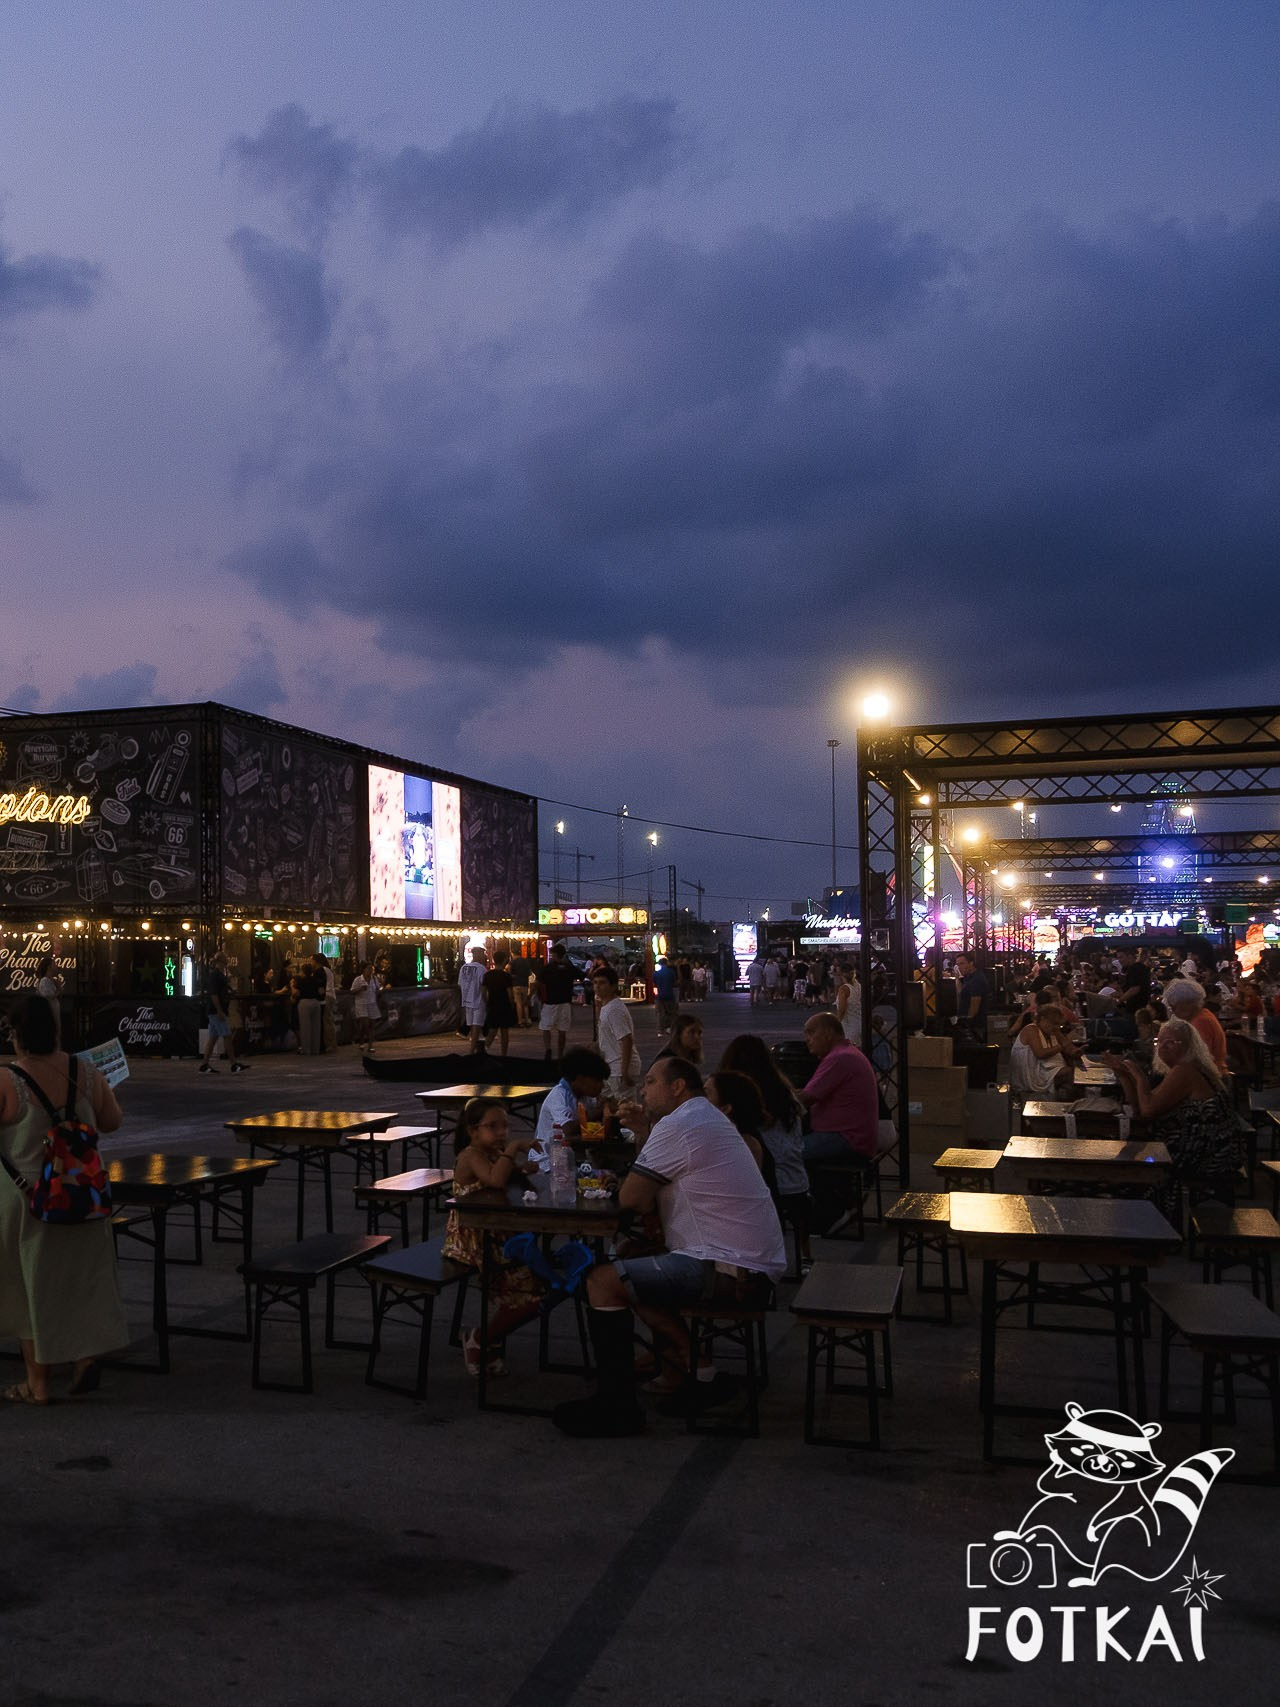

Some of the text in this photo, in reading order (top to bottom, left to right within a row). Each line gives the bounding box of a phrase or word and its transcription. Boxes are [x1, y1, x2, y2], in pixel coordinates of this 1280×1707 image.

[167, 826, 184, 844] 66
[29, 884, 44, 894] 66
[565, 908, 614, 924] STOP
[802, 914, 862, 928] Madison
[22, 931, 52, 956] The
[5, 969, 66, 991] Burr
[135, 1006, 155, 1022] The
[118, 1016, 171, 1032] Champions
[126, 1030, 163, 1047] Burger
